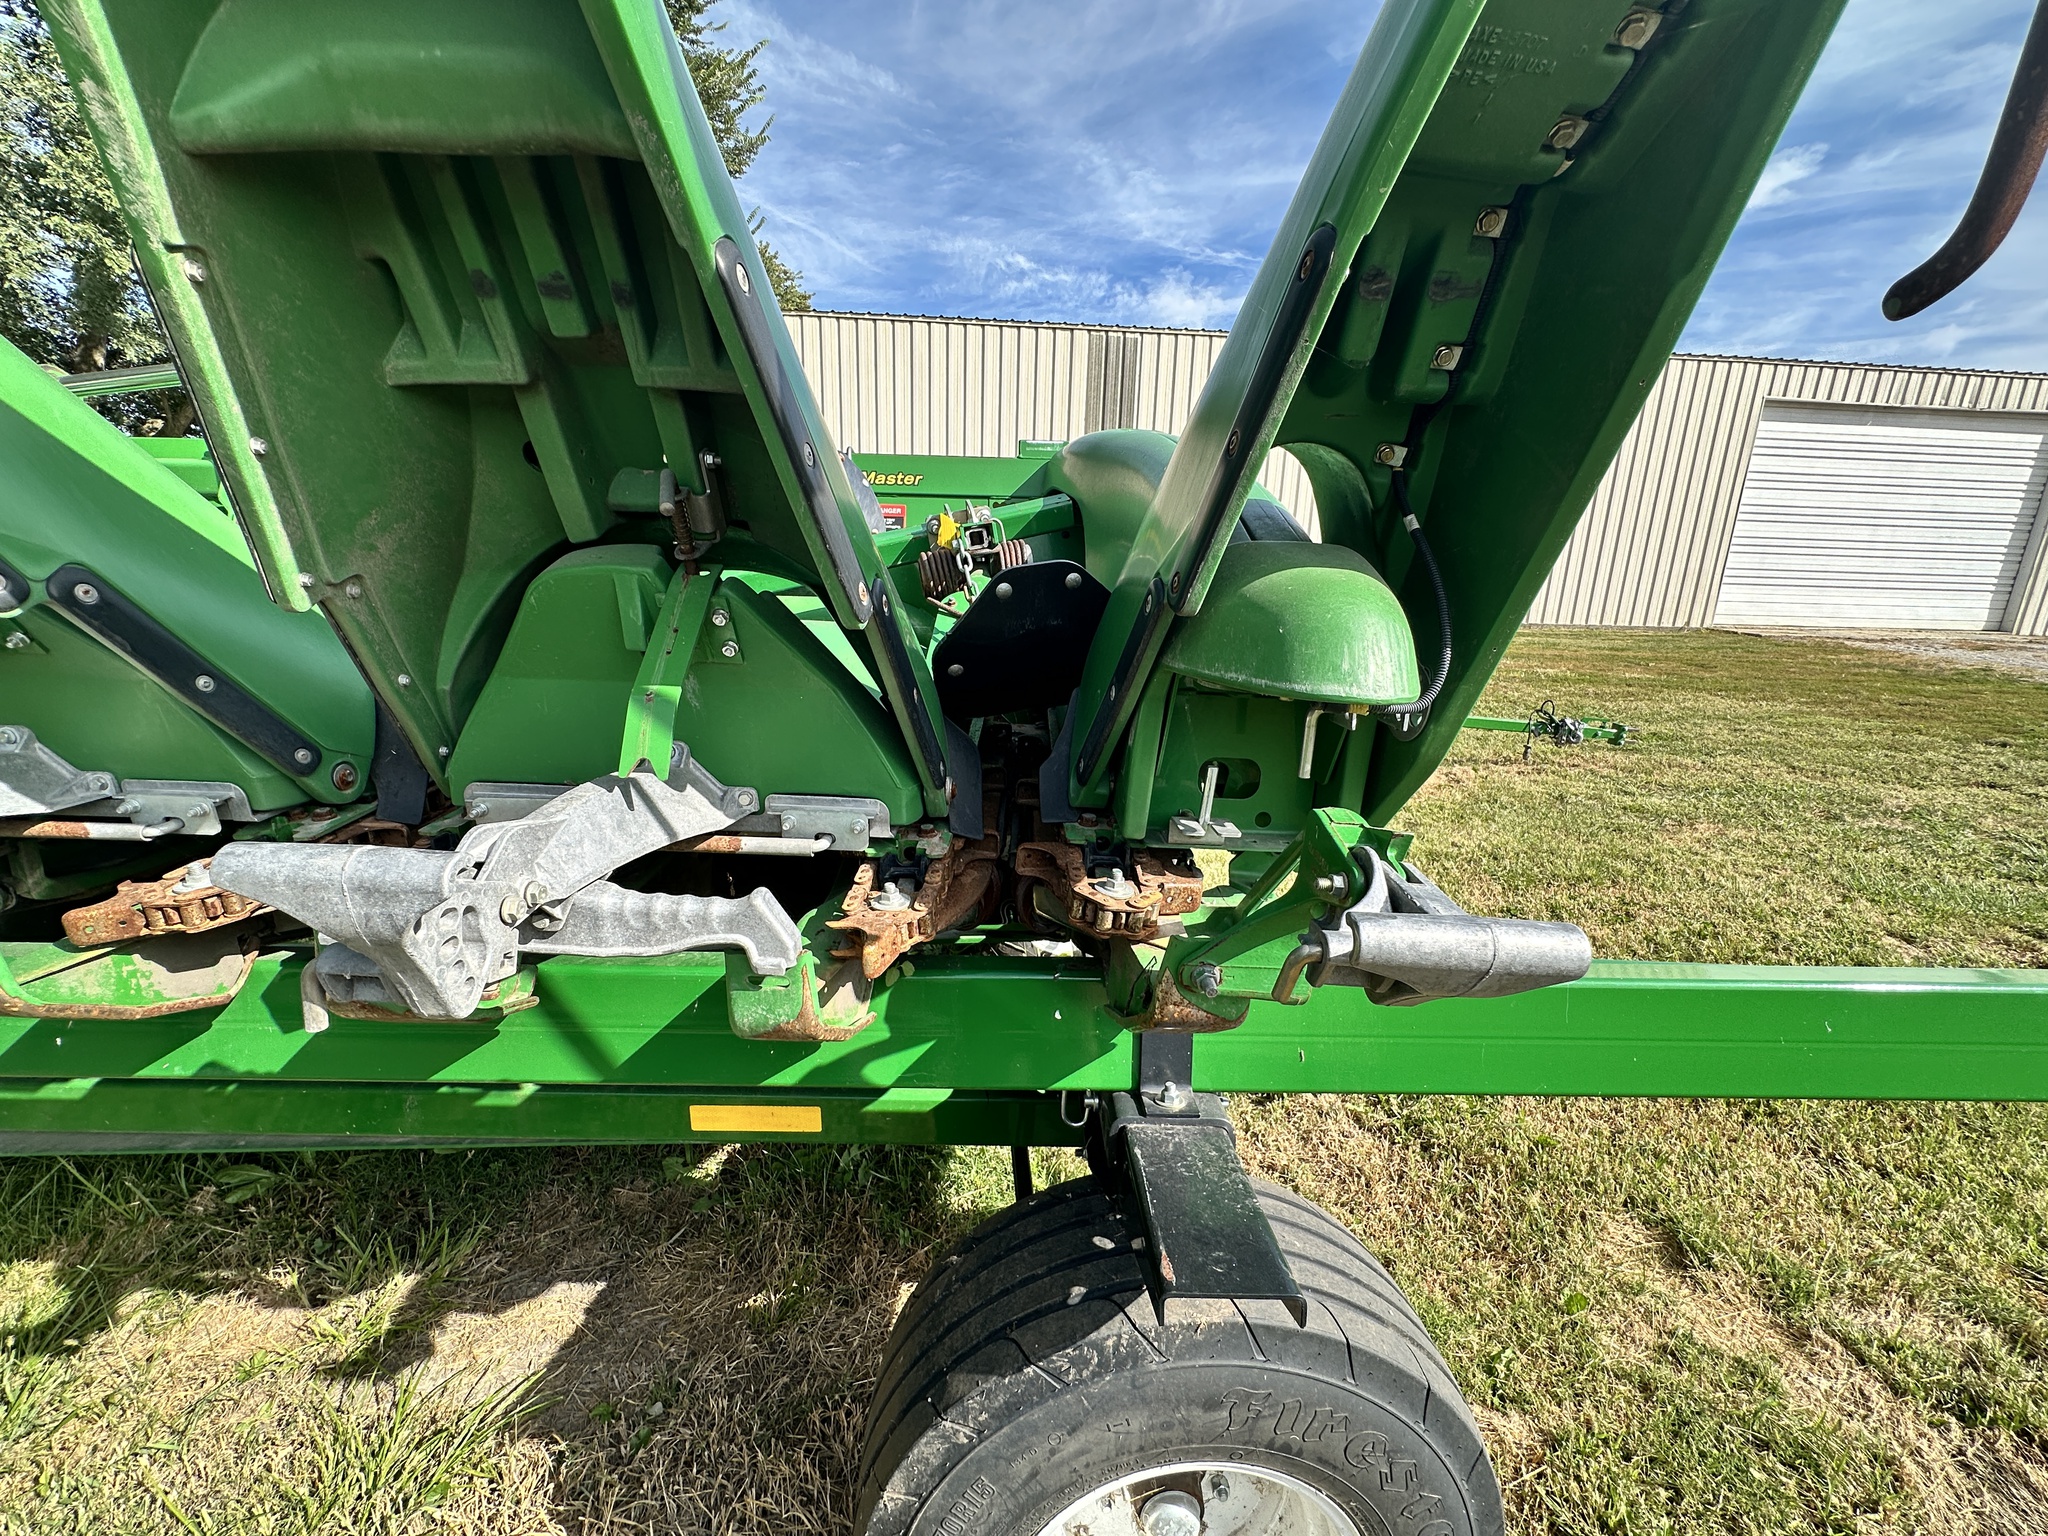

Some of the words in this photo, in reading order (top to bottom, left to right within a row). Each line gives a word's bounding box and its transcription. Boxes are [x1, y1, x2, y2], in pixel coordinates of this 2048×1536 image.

[1460, 48, 1502, 66] MADE
[1503, 53, 1524, 71] IN
[1525, 57, 1557, 76] USA
[861, 469, 924, 486] Master
